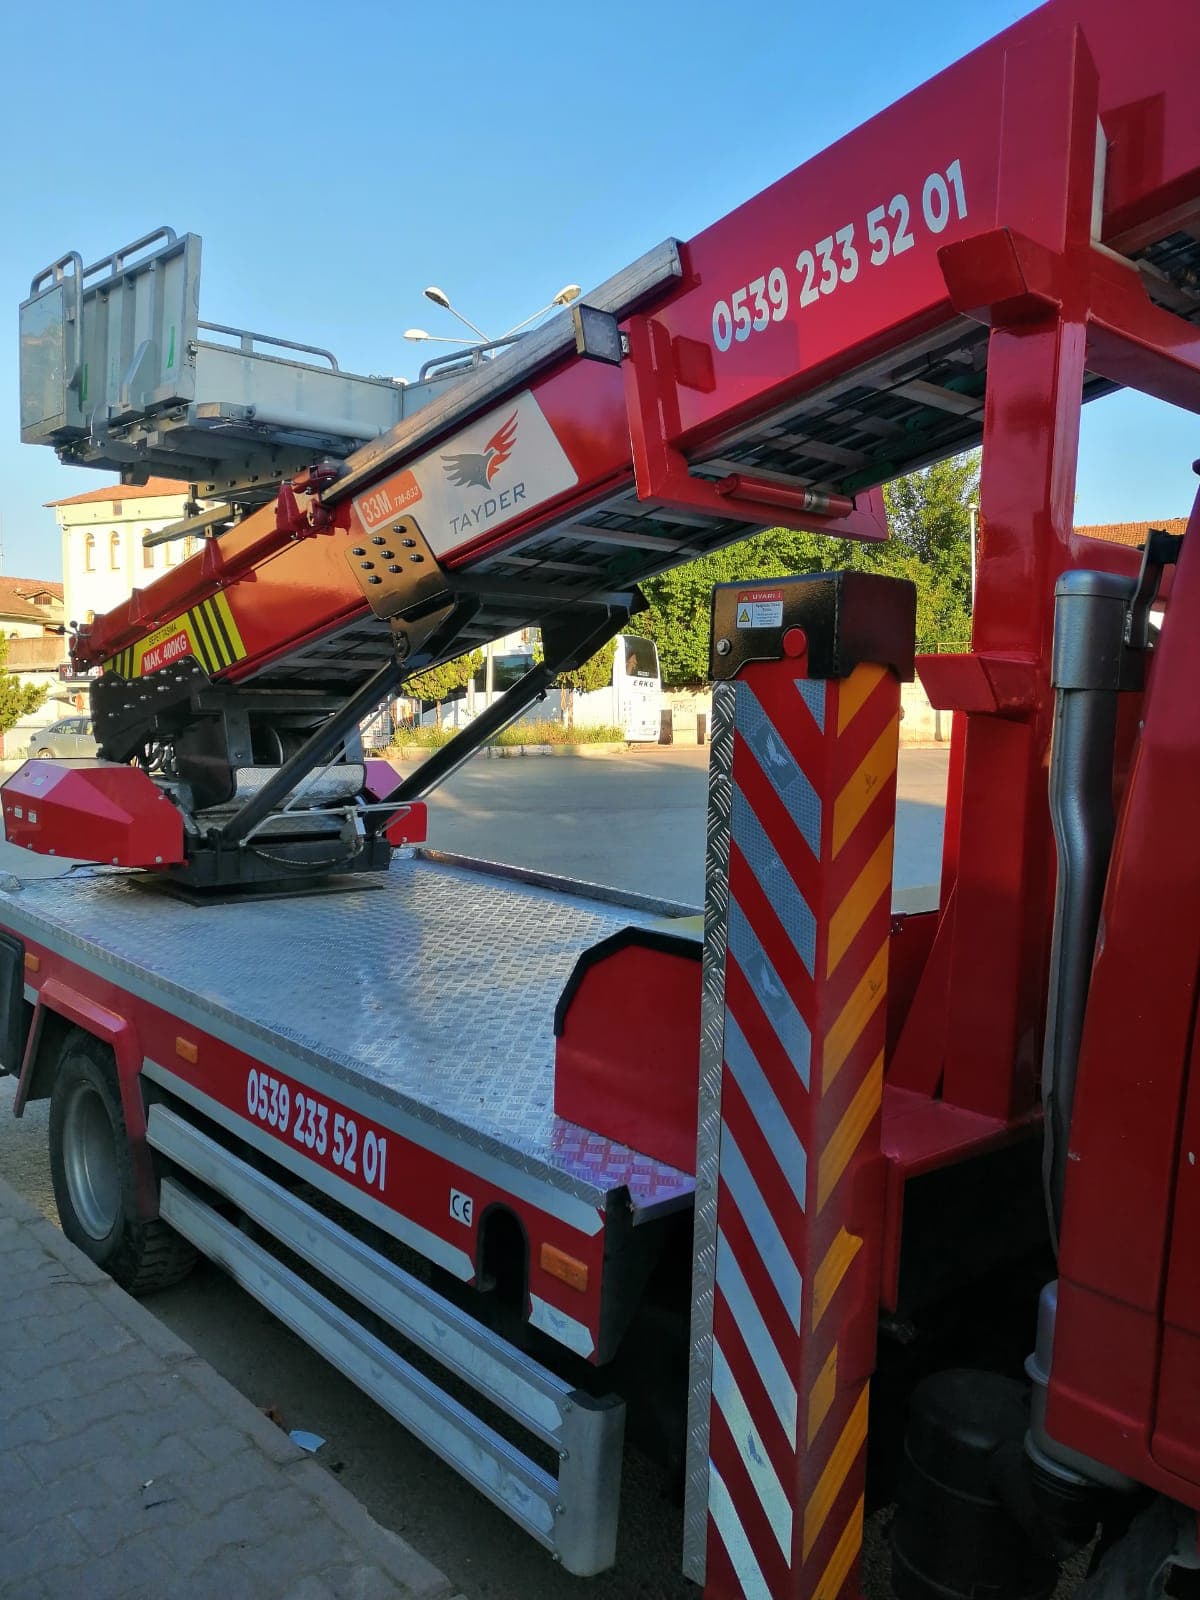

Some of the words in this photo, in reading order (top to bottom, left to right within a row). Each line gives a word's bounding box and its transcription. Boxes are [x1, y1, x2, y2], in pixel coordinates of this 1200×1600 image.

[712, 267, 788, 352] 0539
[796, 223, 859, 308] 233
[866, 194, 915, 266] 52
[922, 158, 968, 234] 01
[361, 489, 393, 523] 33M
[449, 482, 527, 535] TAYDER
[143, 649, 163, 672] MAK.
[163, 634, 187, 660] 400KG
[246, 1068, 290, 1133] 0539
[293, 1092, 329, 1156] 233
[332, 1112, 359, 1174] 52
[362, 1130, 388, 1191] 01
